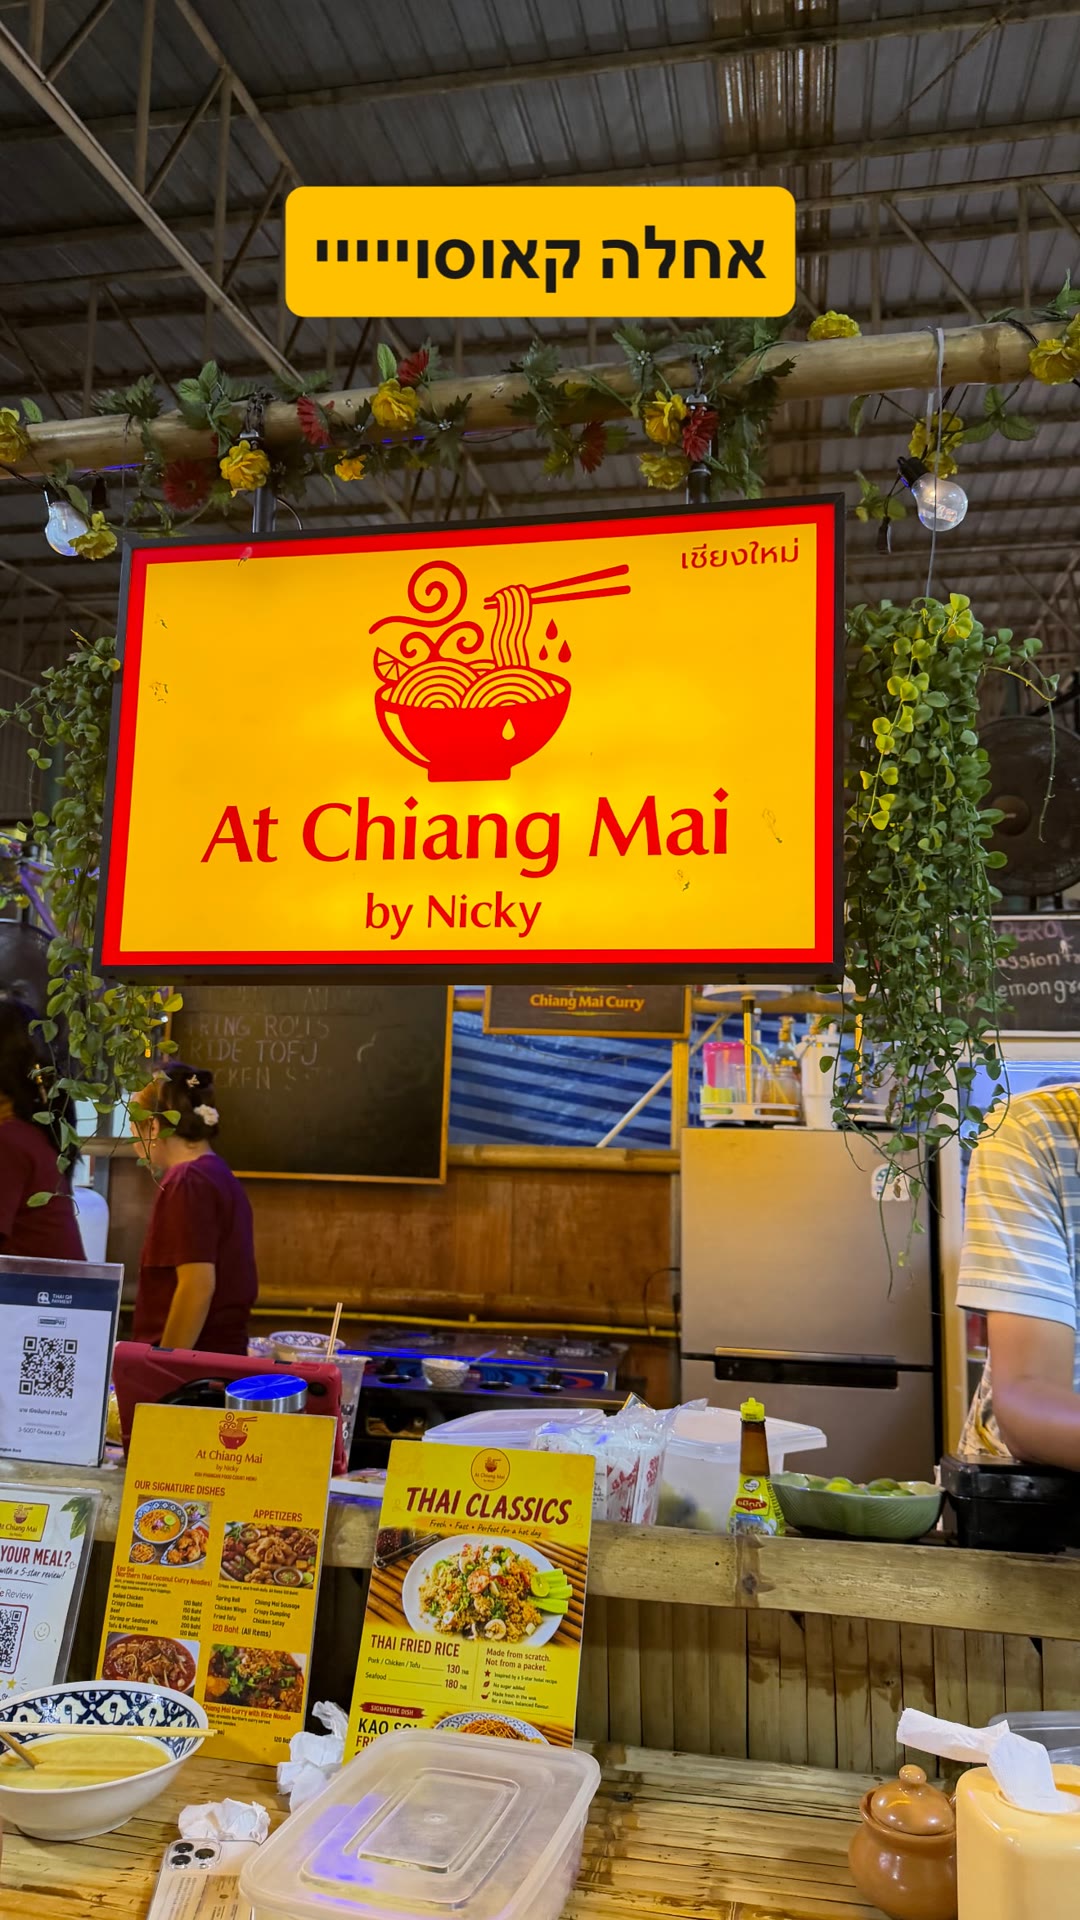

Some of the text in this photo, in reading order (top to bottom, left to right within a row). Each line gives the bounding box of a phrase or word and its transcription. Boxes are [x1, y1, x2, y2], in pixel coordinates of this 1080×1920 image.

[681, 537, 799, 569] เชียงใหม่
[200, 787, 729, 878] At Chiang Mai
[365, 891, 542, 940] by Nicky
[995, 952, 1060, 969] assion
[529, 993, 645, 1011] Chiang Mai Curry
[195, 1449, 263, 1464] At Chiang Mai
[223, 1465, 239, 1473] Nicky
[134, 1480, 225, 1497] OUR SIGNATURE DISHES
[407, 1487, 572, 1525] THAI CLASSICS
[253, 1508, 303, 1522] APPETIZERS
[6, 1523, 26, 1533] Chiang
[429, 1520, 446, 1528] Fresh
[455, 1522, 469, 1530] Fast
[477, 1524, 499, 1533] Perfect
[501, 1526, 511, 1534] for
[518, 1528, 529, 1536] hot
[0, 1545, 72, 1567] YOUR MEAL?
[21, 1567, 40, 1577] 5-star
[41, 1571, 66, 1579] review!
[5, 1588, 34, 1600] Review
[216, 1595, 231, 1603] Spring
[255, 1599, 270, 1607] Chiang
[280, 1601, 300, 1609] Sausage
[254, 1608, 269, 1616] Crispy
[213, 1624, 222, 1632] 120
[224, 1625, 239, 1634] Baht
[252, 1628, 271, 1638] Items)
[371, 1635, 460, 1657] THAI FRIED RICE
[486, 1648, 550, 1662] Made from scratch.
[385, 1659, 405, 1667] Chicken
[410, 1661, 421, 1669] Tofu
[447, 1664, 460, 1674] 130
[500, 1659, 515, 1668] from
[523, 1663, 547, 1671] packet.
[365, 1672, 386, 1680] Seafood
[445, 1679, 458, 1689] 180
[203, 1704, 220, 1713] Chiang
[232, 1708, 247, 1716] Curry
[370, 1705, 399, 1714] SIGNATURE
[358, 1718, 389, 1735] KAO
